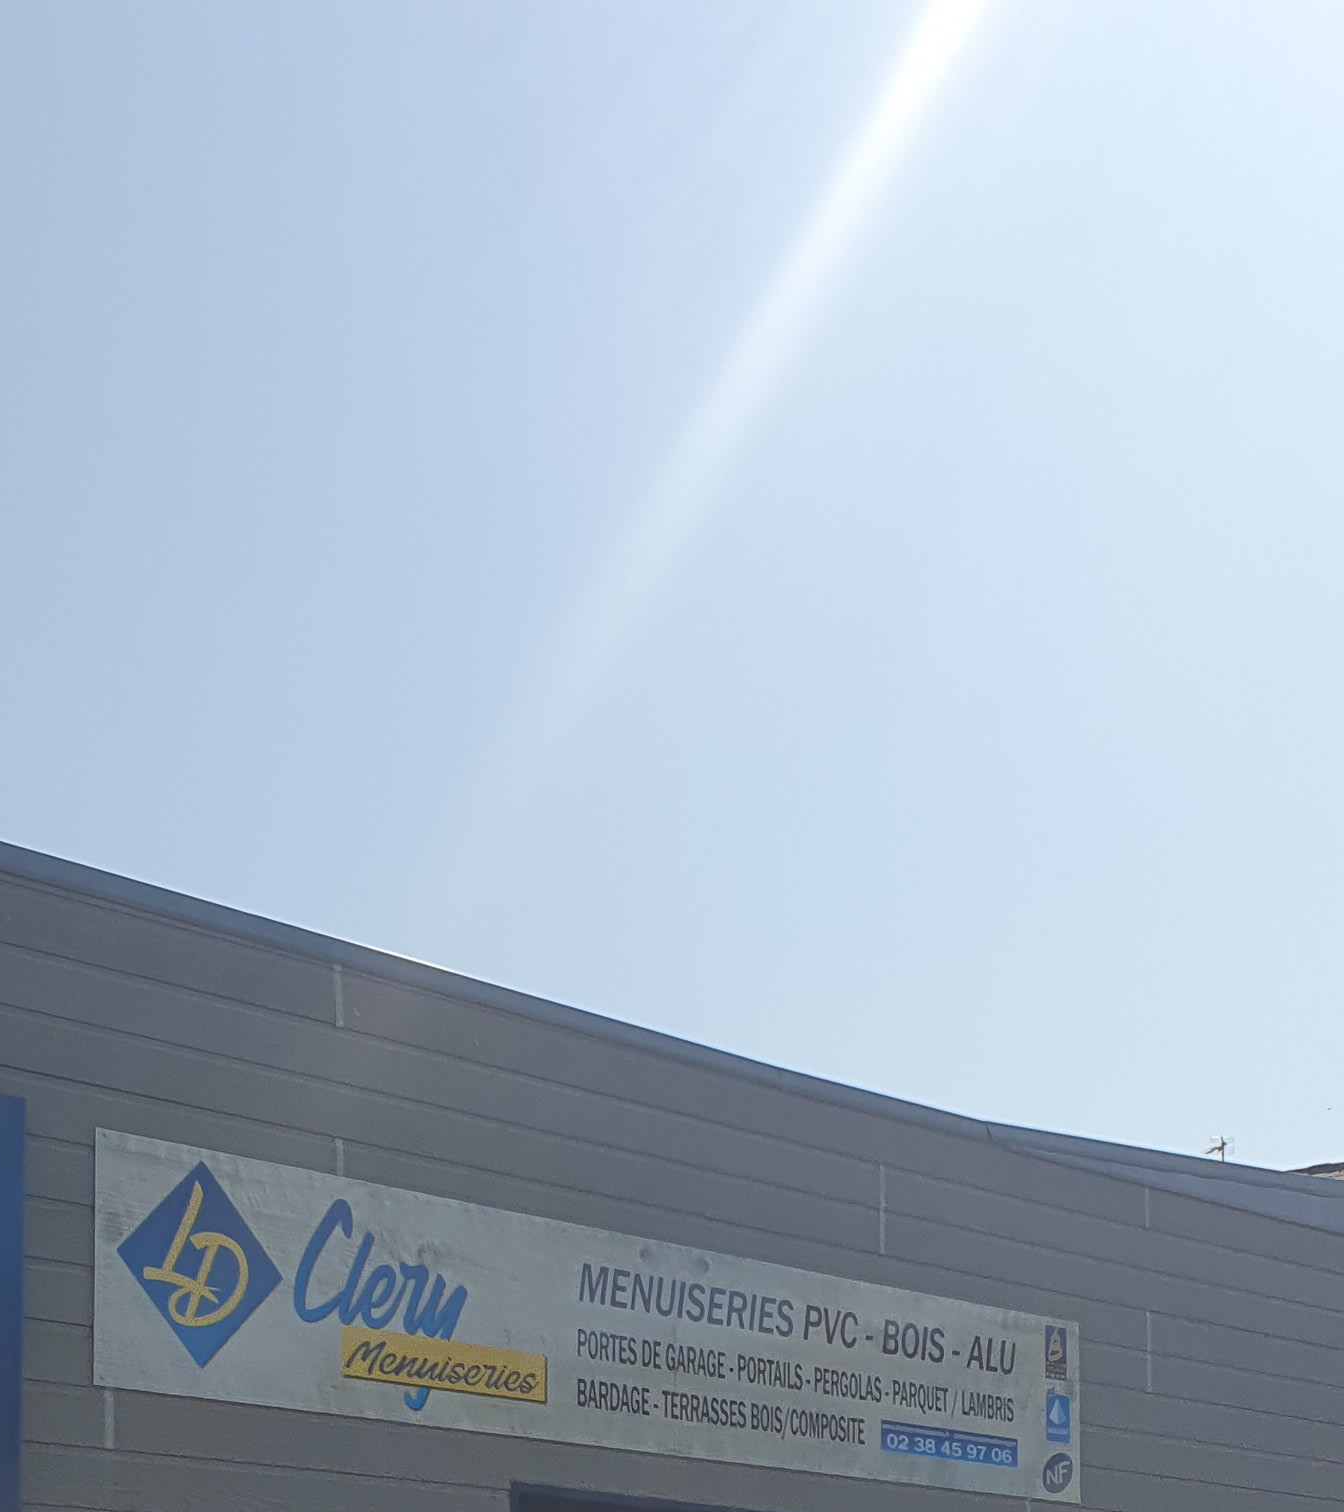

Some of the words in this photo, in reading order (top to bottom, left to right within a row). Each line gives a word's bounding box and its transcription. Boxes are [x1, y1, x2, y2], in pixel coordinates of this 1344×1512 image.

[293, 1198, 470, 1412] Clery
[577, 1262, 794, 1338] MENUISERIES
[803, 1304, 859, 1349] PVC
[882, 1318, 945, 1364] BOIS
[966, 1335, 1016, 1375] ALU
[345, 1340, 539, 1395] Menuiseries
[577, 1328, 637, 1368] PORTES
[641, 1341, 661, 1370] DE
[665, 1343, 726, 1380] GARAGE
[737, 1356, 804, 1392] PORTAILS
[814, 1367, 882, 1403] PERGOLAS
[892, 1379, 948, 1415] PARQUET
[960, 1389, 1015, 1423] LAMBRIS
[576, 1378, 649, 1416] BARDAGE
[662, 1389, 747, 1429] TERRASSES
[750, 1403, 866, 1446] BOIS/COMPOSITE
[886, 1432, 909, 1451] 02
[913, 1434, 935, 1454] 38
[939, 1438, 963, 1458] 45
[966, 1442, 987, 1460] 97
[991, 1444, 1013, 1464] 06
[1045, 1461, 1070, 1485] NF
